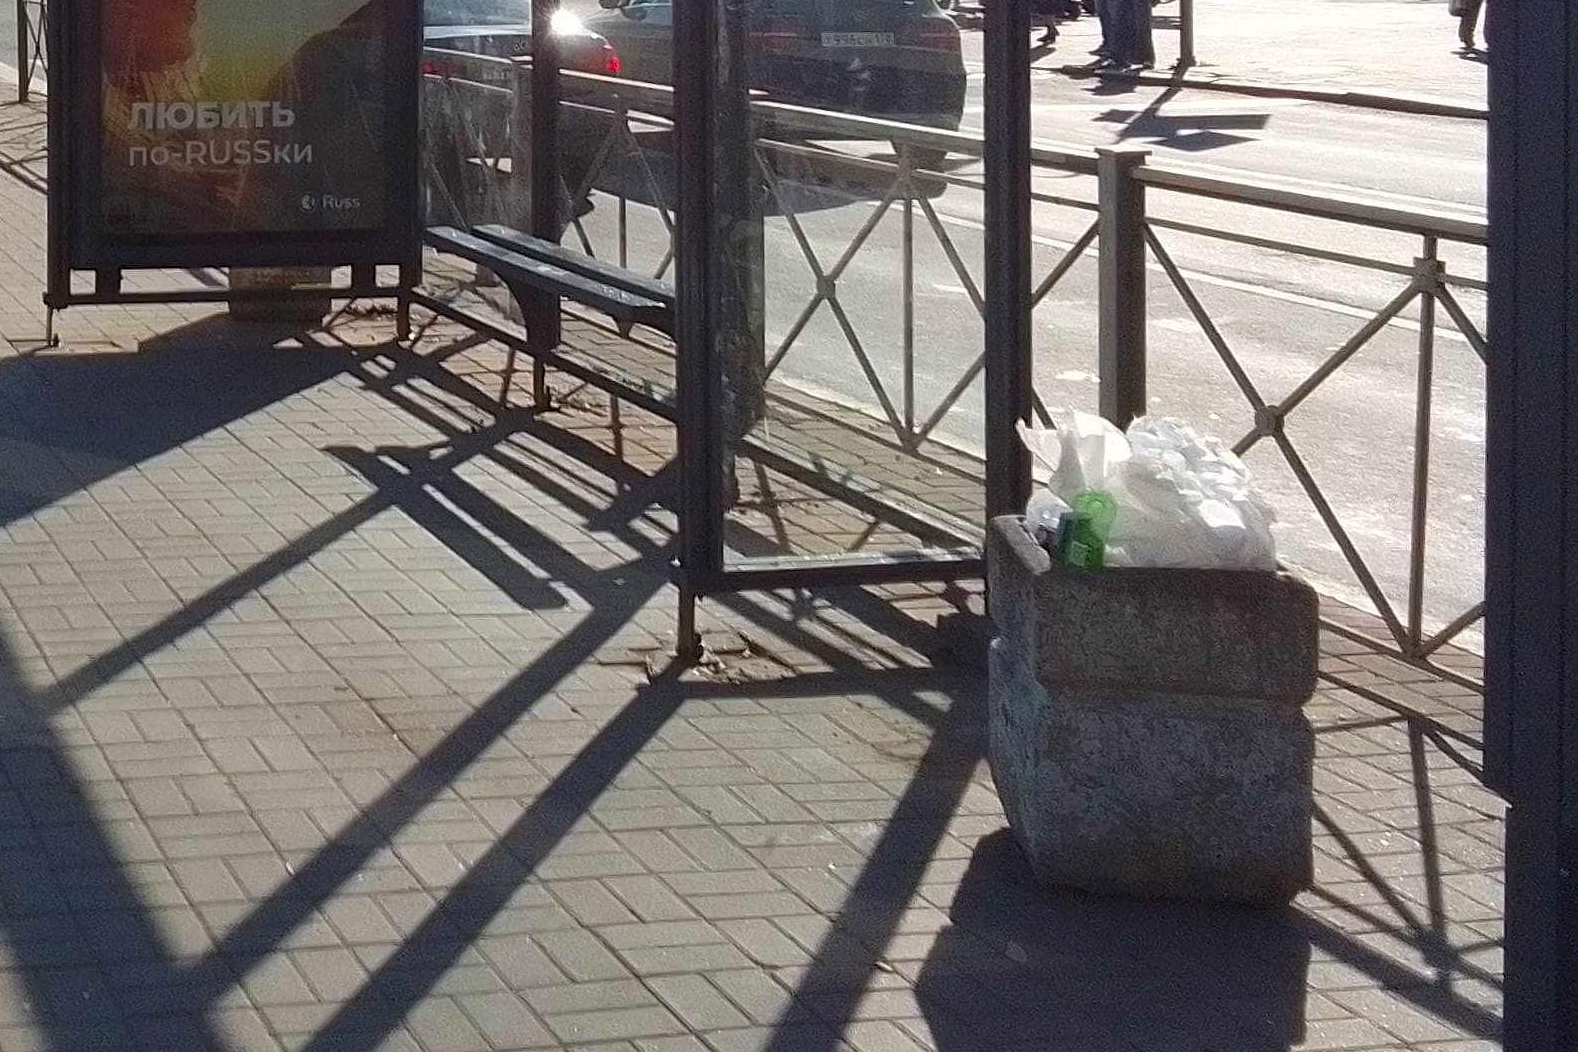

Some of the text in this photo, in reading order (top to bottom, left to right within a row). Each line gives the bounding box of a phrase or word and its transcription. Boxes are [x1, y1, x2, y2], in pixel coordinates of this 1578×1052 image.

[129, 101, 296, 129] ЛЮБИТЬ
[129, 139, 313, 167] по-RUSSки
[322, 195, 361, 210] Russ
